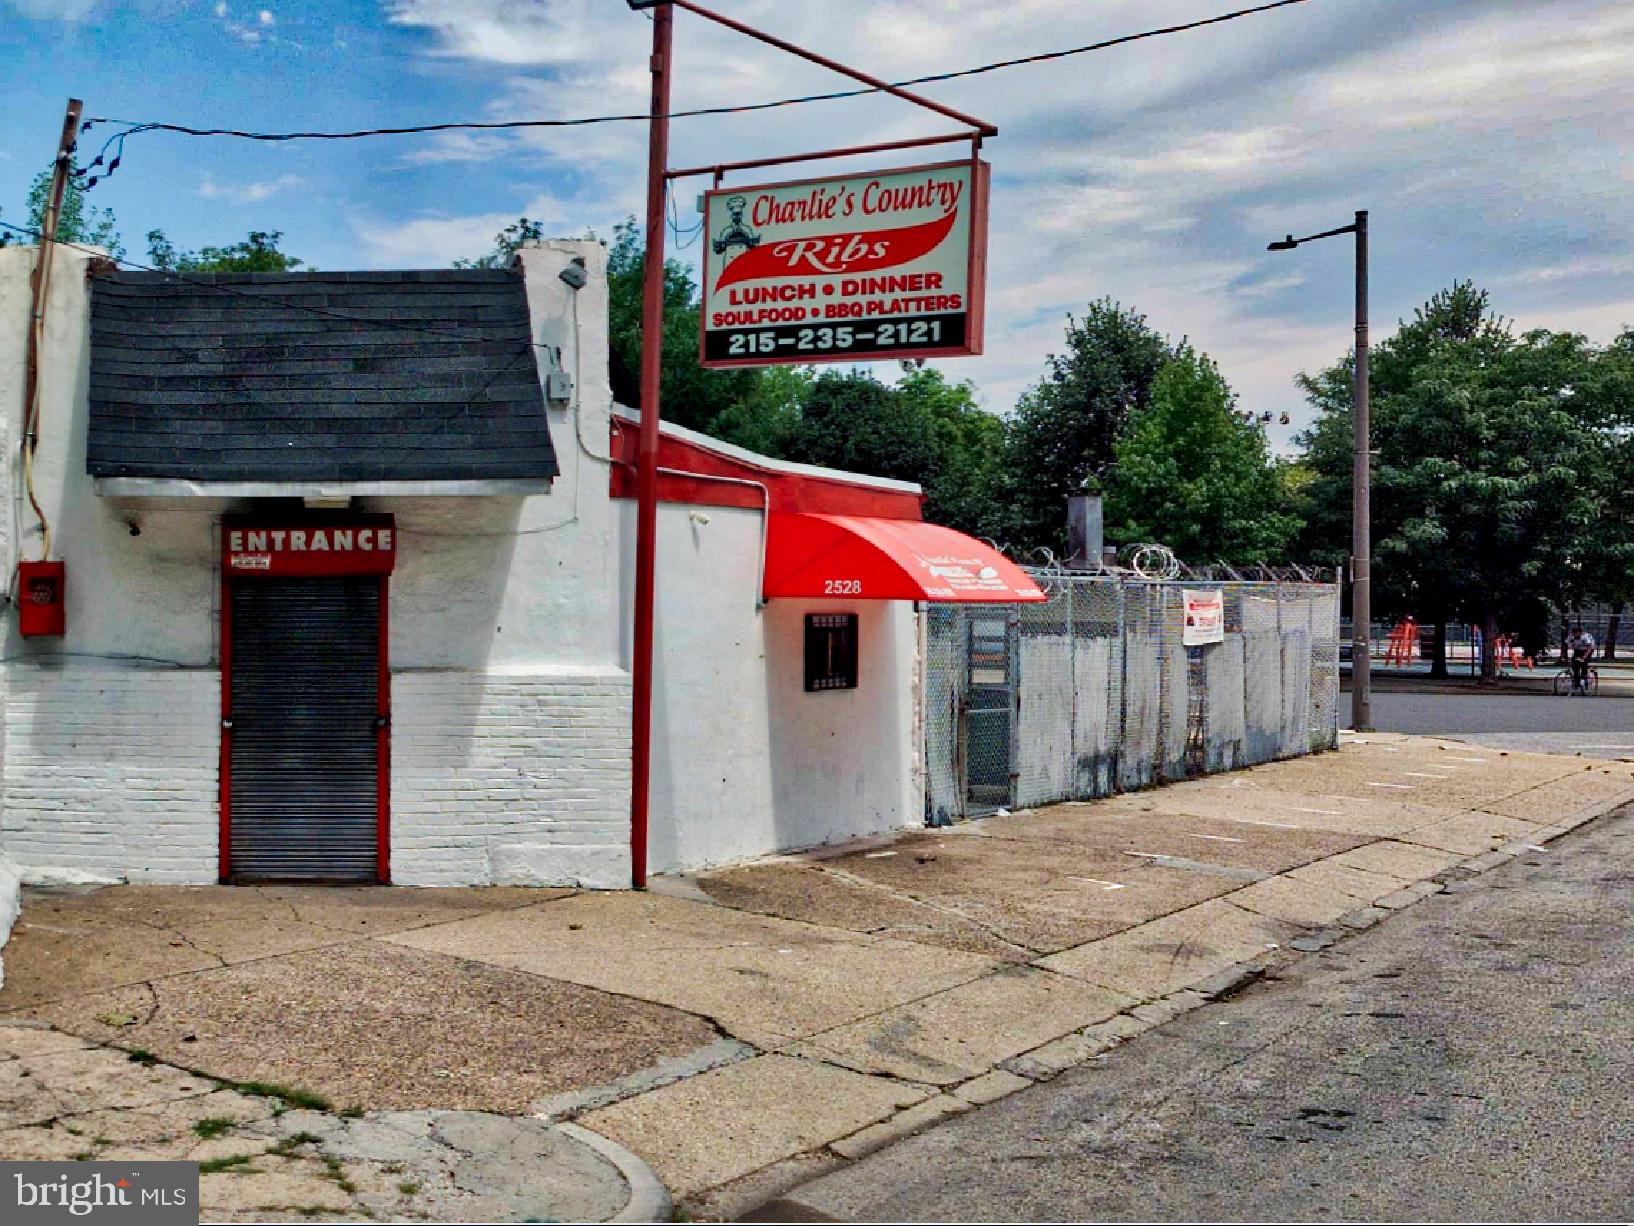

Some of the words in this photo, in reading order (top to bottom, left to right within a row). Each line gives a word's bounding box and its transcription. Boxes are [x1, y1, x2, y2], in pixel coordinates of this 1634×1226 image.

[752, 186, 855, 227] Charlie's
[862, 179, 963, 215] Country
[773, 234, 891, 273] Ribs
[729, 283, 816, 305] LUNCH
[841, 272, 943, 296] DINNER
[713, 307, 806, 327] SOULFOOD
[825, 300, 864, 319] BBQ
[866, 294, 961, 315] PLATTERS
[729, 321, 942, 354] 215-235-2121
[230, 529, 392, 551] ENTRANCE
[825, 580, 861, 594] 2528
